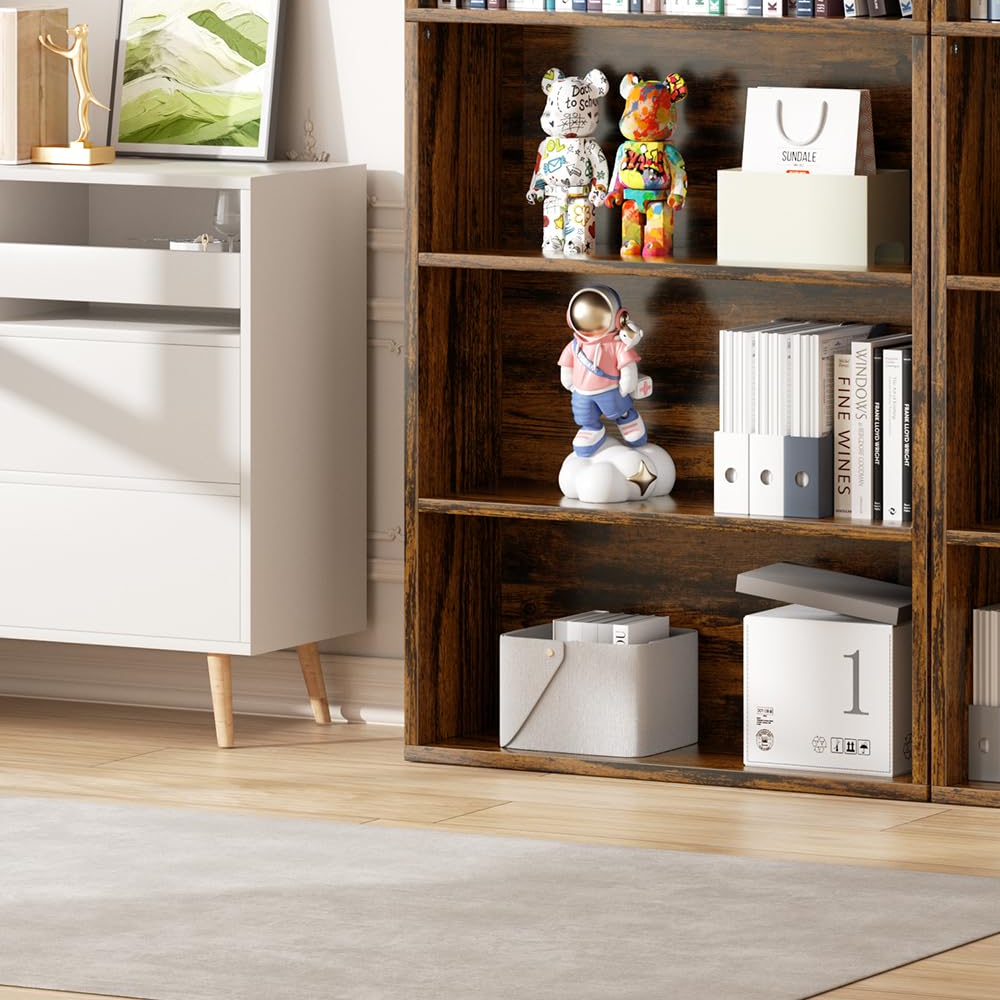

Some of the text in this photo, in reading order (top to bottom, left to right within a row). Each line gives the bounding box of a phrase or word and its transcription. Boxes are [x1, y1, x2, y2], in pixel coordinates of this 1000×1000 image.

[768, 2, 777, 11] K
[782, 150, 816, 162] SUNDALE
[856, 348, 868, 420] WINDOWS
[838, 376, 850, 496] FINE WINES
[843, 649, 869, 716] 1
